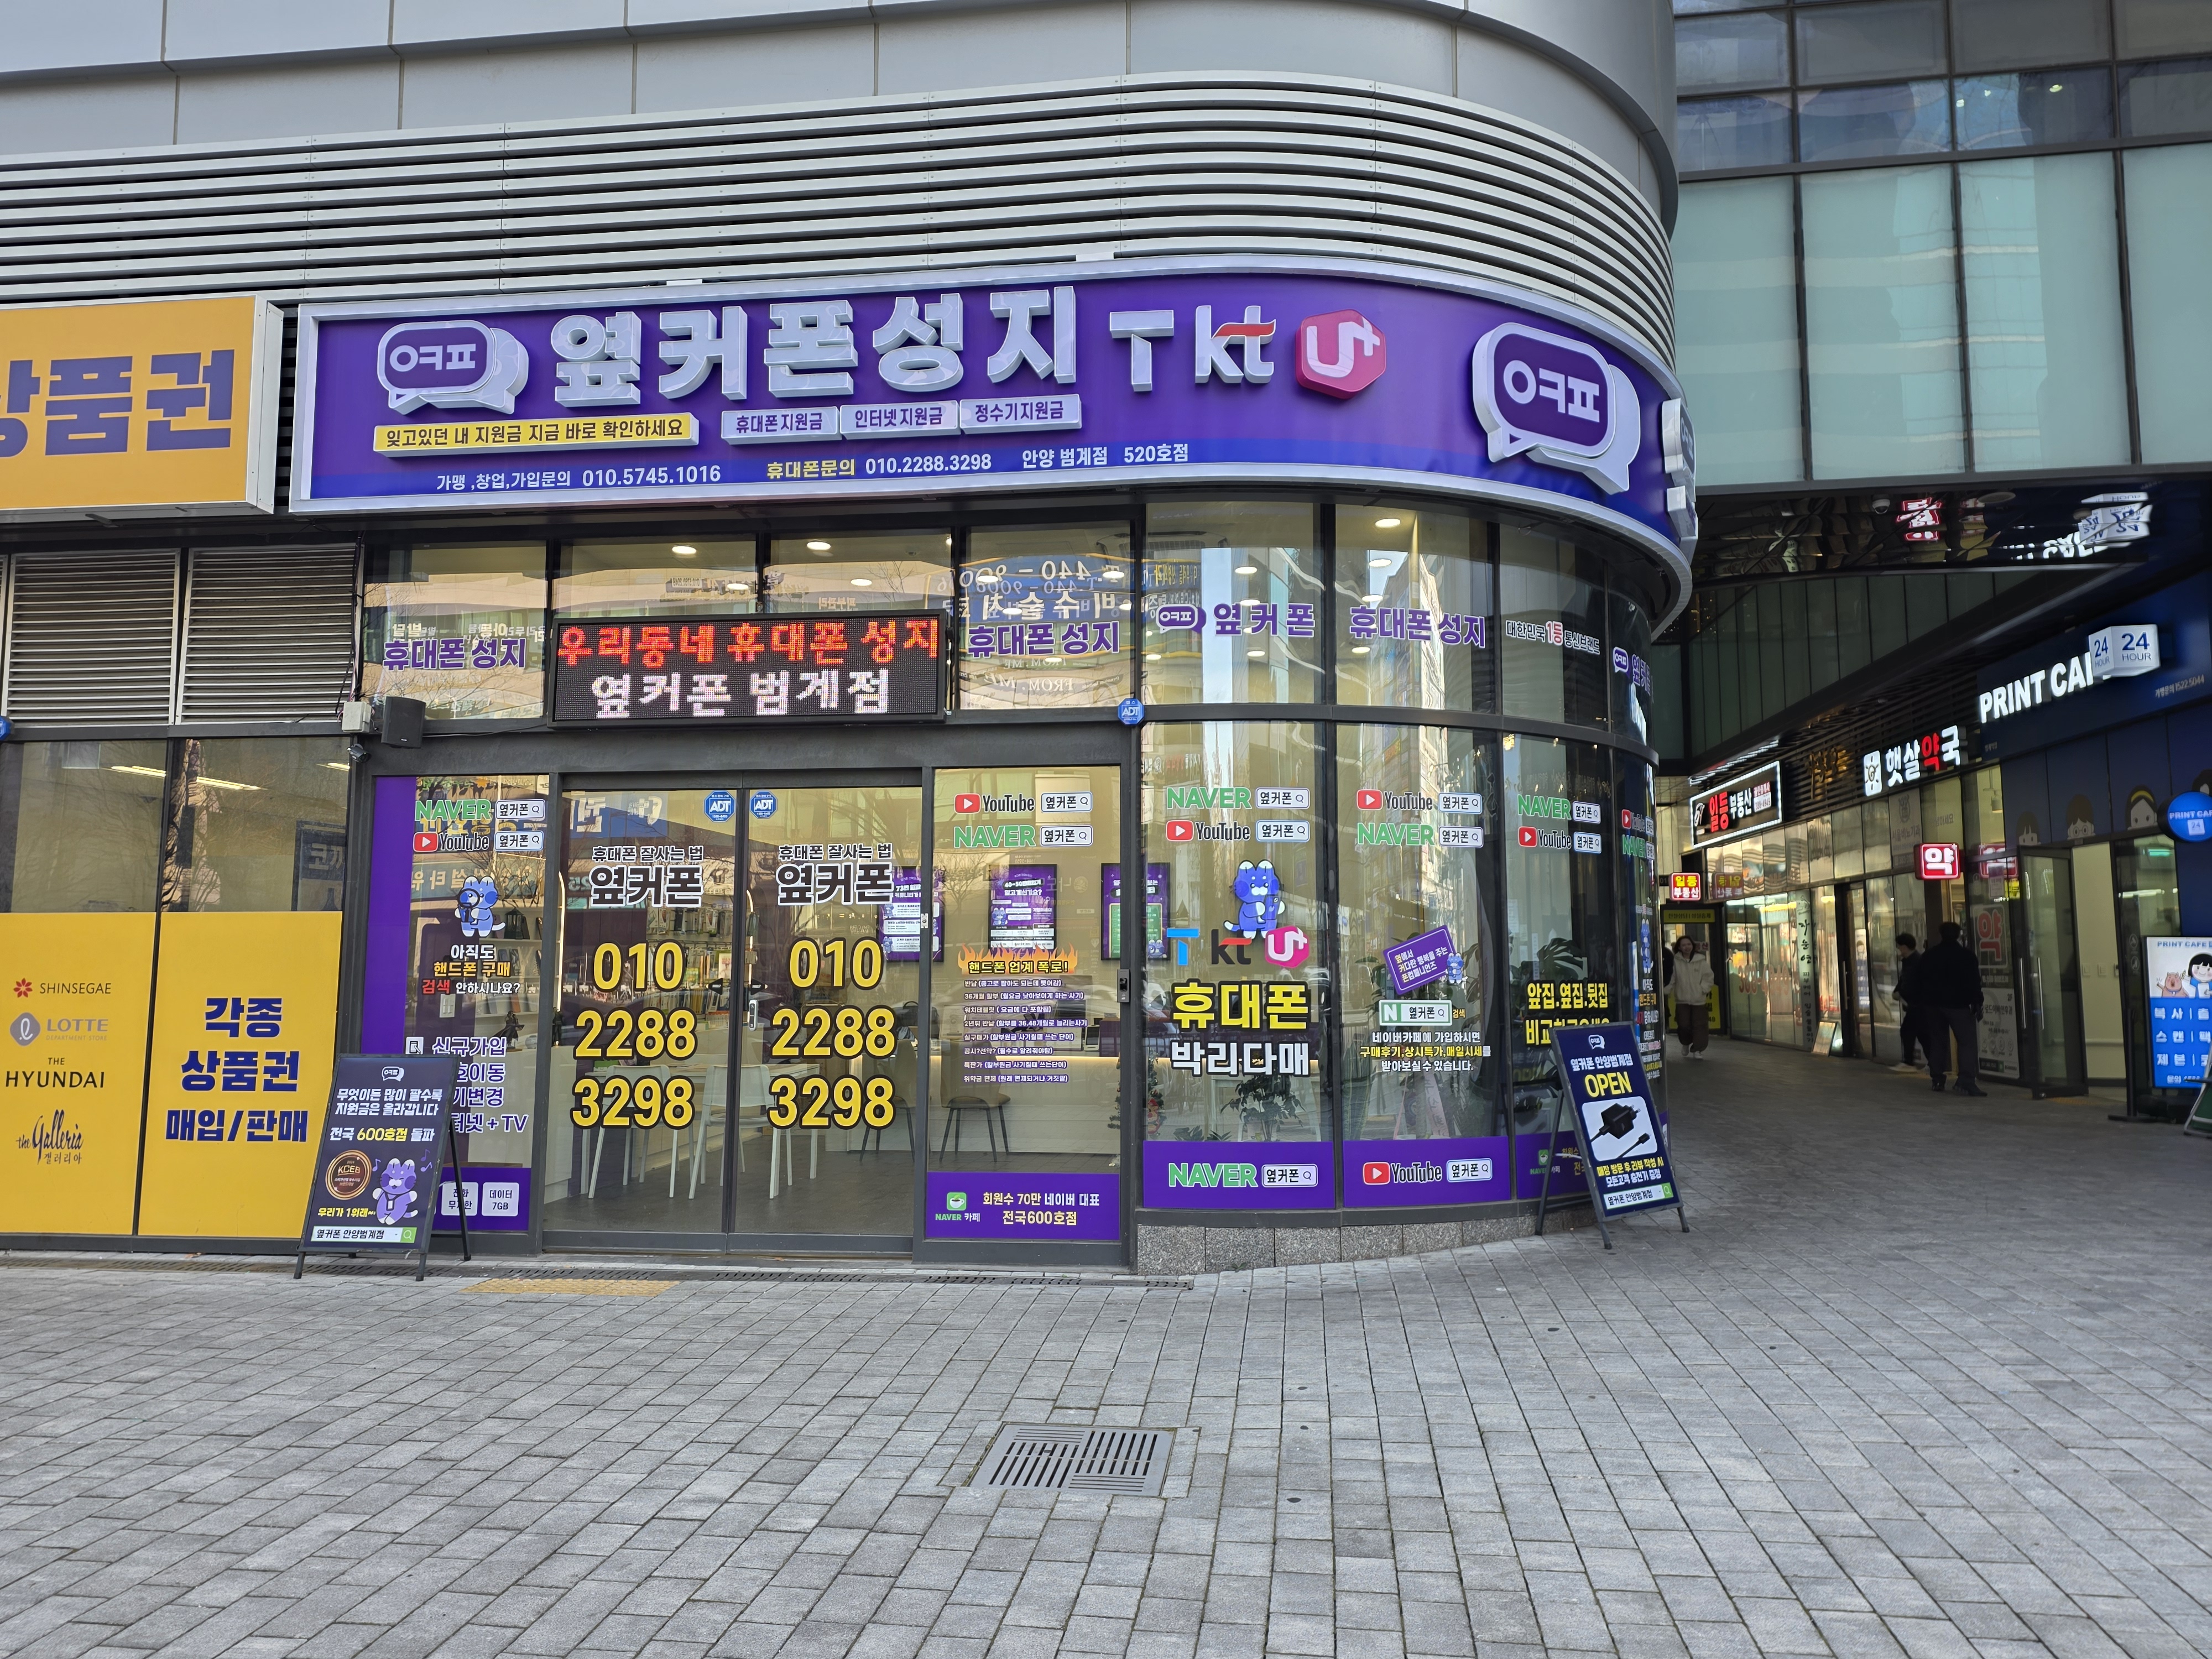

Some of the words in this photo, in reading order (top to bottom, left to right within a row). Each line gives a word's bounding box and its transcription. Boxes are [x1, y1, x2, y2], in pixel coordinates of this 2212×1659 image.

[1109, 310, 1174, 392] T
[1195, 305, 1276, 383] kt
[974, 401, 1063, 422] 정수기지원금
[387, 428, 448, 447] 잊고있던
[455, 427, 468, 445] 내
[475, 425, 521, 444] 지원금
[529, 424, 559, 442] 지금
[566, 422, 596, 440] 바로
[602, 418, 682, 439] 확인하세요
[437, 473, 465, 490] 가맹
[582, 466, 721, 487] 010.5745.1016
[767, 460, 855, 479] 휴대폰문의
[866, 454, 992, 474] 010.2288.3298
[1022, 450, 1054, 468] 안양
[1060, 447, 1108, 466] 범계점
[1124, 444, 1188, 462] 520호점
[1349, 604, 1432, 641] 휴대폰
[1437, 612, 1486, 649] 성지
[557, 624, 714, 667] 우리동네
[727, 622, 848, 665] 휴대폰
[861, 619, 938, 663] 성지
[968, 623, 1055, 658] 휴대폰
[1061, 620, 1120, 655] 성지
[1506, 620, 1546, 643] 대한민국
[1546, 621, 1563, 646] 1등
[1564, 630, 1600, 655] 통신브랜드
[2094, 636, 2109, 658] 24
[2122, 632, 2150, 650] 24
[383, 639, 465, 670] 휴대폰
[471, 638, 526, 669] 성지
[2095, 656, 2110, 668] HOUR
[2122, 652, 2152, 661] HOUR
[592, 672, 731, 719] 옆커폰
[750, 669, 888, 716] 범계점
[1979, 670, 2045, 723] PRINT
[2051, 651, 2112, 697] CA
[1122, 707, 1140, 716] ADT
[1886, 726, 1960, 787] 햇살약국
[709, 801, 731, 812] ADT
[755, 800, 773, 810] ADT
[983, 793, 1035, 813] YouTube
[1045, 795, 1077, 810] 옆커폰
[1166, 787, 1252, 809] NAVER
[1260, 791, 1292, 805] 옆커폰
[1384, 791, 1433, 810] YouTube
[1442, 796, 1469, 810] 옆커폰
[1517, 794, 1572, 820] NAVER
[415, 799, 492, 821] NAVER
[499, 804, 529, 816] 옆커폰
[1575, 805, 1592, 818] 옆커폰
[1709, 791, 1729, 832] 일등
[1730, 788, 1752, 820] 부동산
[2169, 811, 2195, 820] PRINT
[954, 825, 1036, 848] NAVER
[1044, 828, 1076, 843] 옆커폰
[1195, 821, 1251, 841] YouTube
[1262, 825, 1294, 838] 옆커폰
[1357, 822, 1435, 846] NAVER
[1442, 831, 1469, 844] 옆커폰
[1537, 829, 1572, 849] YouTube
[439, 832, 489, 851] YouTube
[499, 834, 529, 848] 옆커폰
[1577, 836, 1594, 849] 옆커폰
[1623, 834, 1646, 858] NAVER
[592, 846, 636, 862] 휴대폰
[641, 846, 684, 862] 잘사는
[688, 845, 704, 860] 법
[779, 844, 823, 860] 휴대폰
[828, 843, 873, 859] 잘사는
[878, 843, 892, 858] 법
[1925, 846, 1954, 875] 약
[589, 863, 702, 907] 옆커폰
[776, 861, 894, 905] 옆커폰
[1676, 876, 1697, 886] 일등
[1674, 887, 1698, 898] 부동산
[451, 944, 494, 959] 아직도
[1211, 928, 1252, 965] kt
[592, 941, 685, 990] 010
[789, 939, 883, 989] 010
[1395, 949, 1414, 964] 옆에서
[1398, 960, 1417, 973] 커다란
[1416, 952, 1436, 966] 행복을
[1435, 946, 1448, 957] 주는
[434, 962, 477, 977] 핸드폰
[482, 961, 510, 977] 구매
[968, 961, 1006, 974] 핸드폰
[1009, 961, 1034, 974] 업계
[1037, 961, 1068, 973] 폭로!
[40, 982, 111, 994] SHINSEGAE
[422, 979, 450, 994] 검색
[456, 982, 520, 994] 안하시나요?
[1527, 983, 1608, 1009] 앞집.옆집.뒷집
[1173, 982, 1309, 1029] 휴대폰
[1409, 1007, 1436, 1019] 옆커폰
[1452, 1009, 1465, 1019] 검색
[46, 1019, 108, 1032] LOTTE
[205, 997, 283, 1038] 각종
[574, 1009, 697, 1058] 2288
[771, 1007, 895, 1058] 2288
[1372, 1032, 1432, 1044] 네이버카페에
[1434, 1031, 1480, 1043] 가입하시면
[432, 1036, 507, 1057] 신규가입
[1171, 1042, 1310, 1076] 박리다매
[1595, 1053, 1634, 1069] 안양범계점
[6, 1071, 105, 1088] HYUNDAI
[181, 1050, 300, 1092] 상품권
[1585, 1071, 1632, 1098] OPEN
[337, 1089, 382, 1100] 무엇이든
[383, 1089, 406, 1101] 많이
[409, 1089, 442, 1101] 팔수록
[571, 1077, 693, 1128] 3298
[768, 1076, 895, 1128] 3298
[335, 1103, 380, 1115] 지원금은
[383, 1103, 439, 1115] 올라갑니다
[165, 1109, 309, 1142] 매입/판매
[452, 1113, 484, 1134] 터넷
[502, 1113, 529, 1133] TV
[330, 1128, 354, 1140] 전국
[357, 1128, 408, 1141] 600호점
[411, 1129, 435, 1141] 돌파
[44, 1152, 82, 1164] 갤러리아
[1597, 1165, 1610, 1176] 매장
[1610, 1163, 1624, 1174] 방문
[1624, 1162, 1631, 1172] 후
[1631, 1160, 1644, 1170] 리뷰
[1644, 1157, 1656, 1168] 작성
[1657, 1156, 1664, 1167] 시
[338, 1165, 361, 1173] KCEB
[1168, 1162, 1259, 1188] NAVER
[1266, 1168, 1300, 1183] 옆커폰
[1391, 1161, 1442, 1183] YouTube
[1452, 1163, 1479, 1178] 옆커폰
[1606, 1173, 1630, 1187] 모든고객
[1631, 1170, 1648, 1183] 충전기
[490, 1190, 512, 1199] 데이터
[983, 1192, 1014, 1206] 회원수
[1016, 1192, 1042, 1206] 70만
[1045, 1193, 1076, 1206] 네이버
[1079, 1193, 1100, 1206] 대표
[1625, 1190, 1653, 1202] 안양범계점
[964, 1213, 980, 1222] 카페
[1003, 1211, 1077, 1225] 전국600호점
[343, 1229, 384, 1239] 안양범계점
